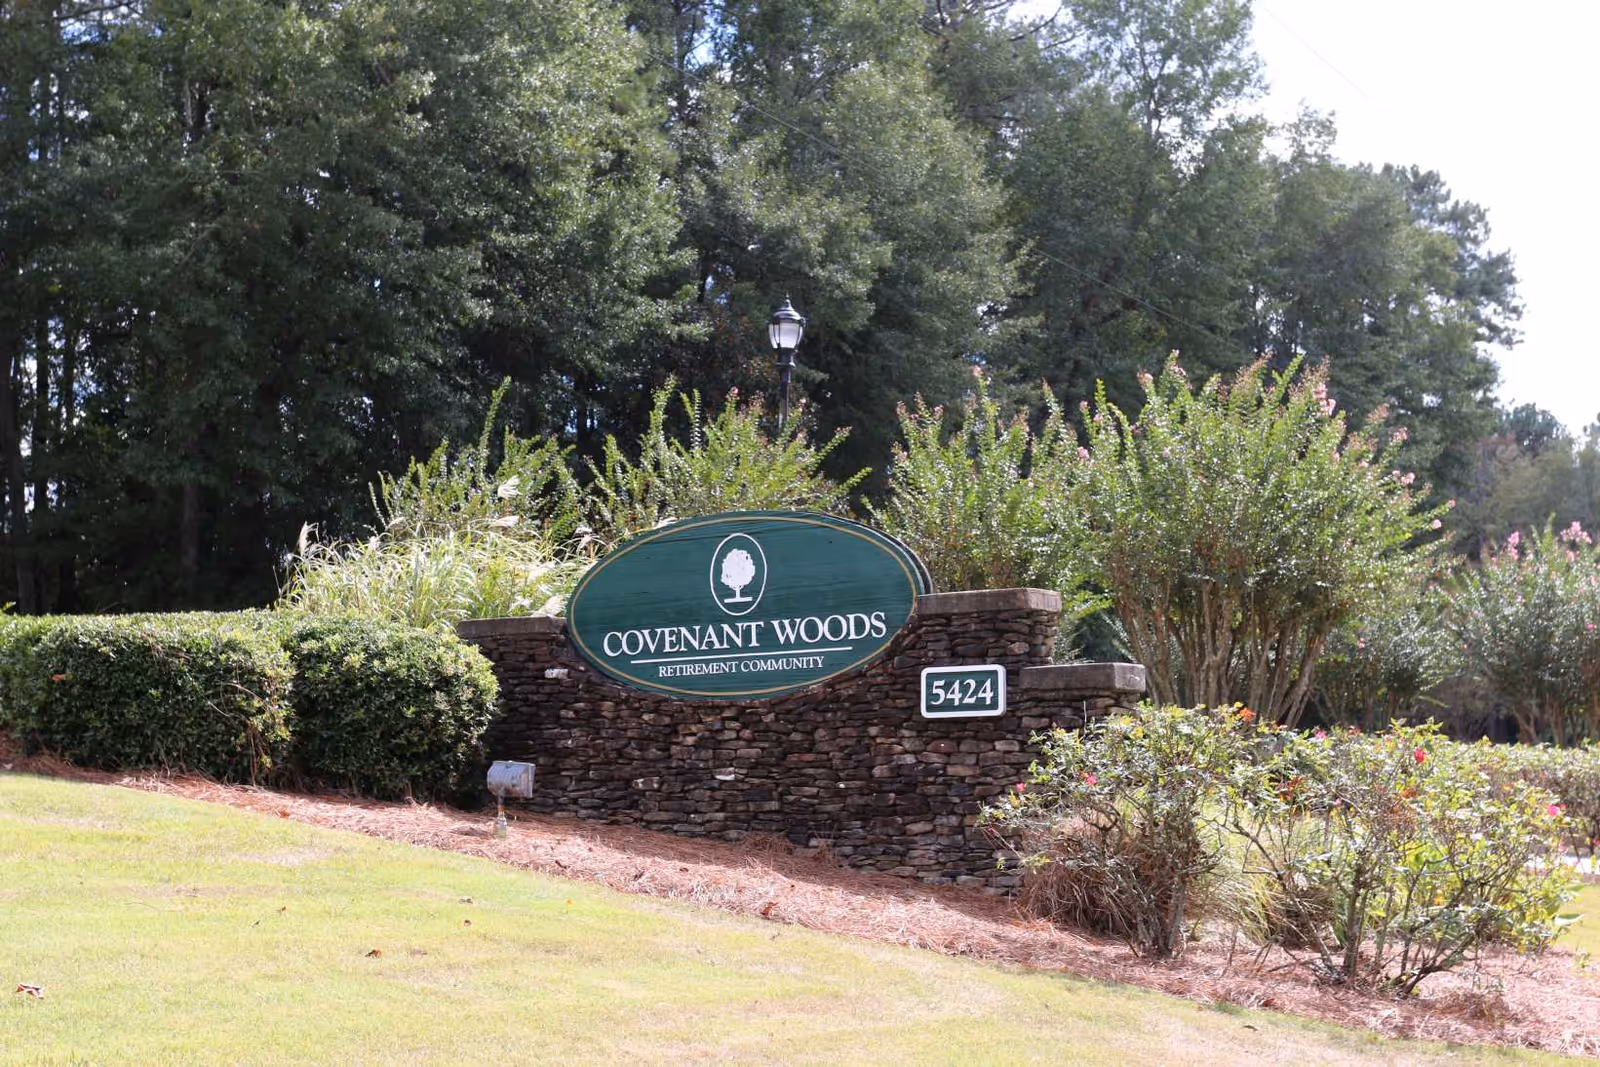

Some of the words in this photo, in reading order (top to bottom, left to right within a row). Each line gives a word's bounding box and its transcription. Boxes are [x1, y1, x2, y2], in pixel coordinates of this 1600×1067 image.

[603, 621, 764, 657] COVENANT
[770, 611, 887, 646] WOODS
[658, 663, 738, 678] RETIREMENT
[740, 656, 825, 673] COMMUNITY
[930, 678, 994, 706] 5424
